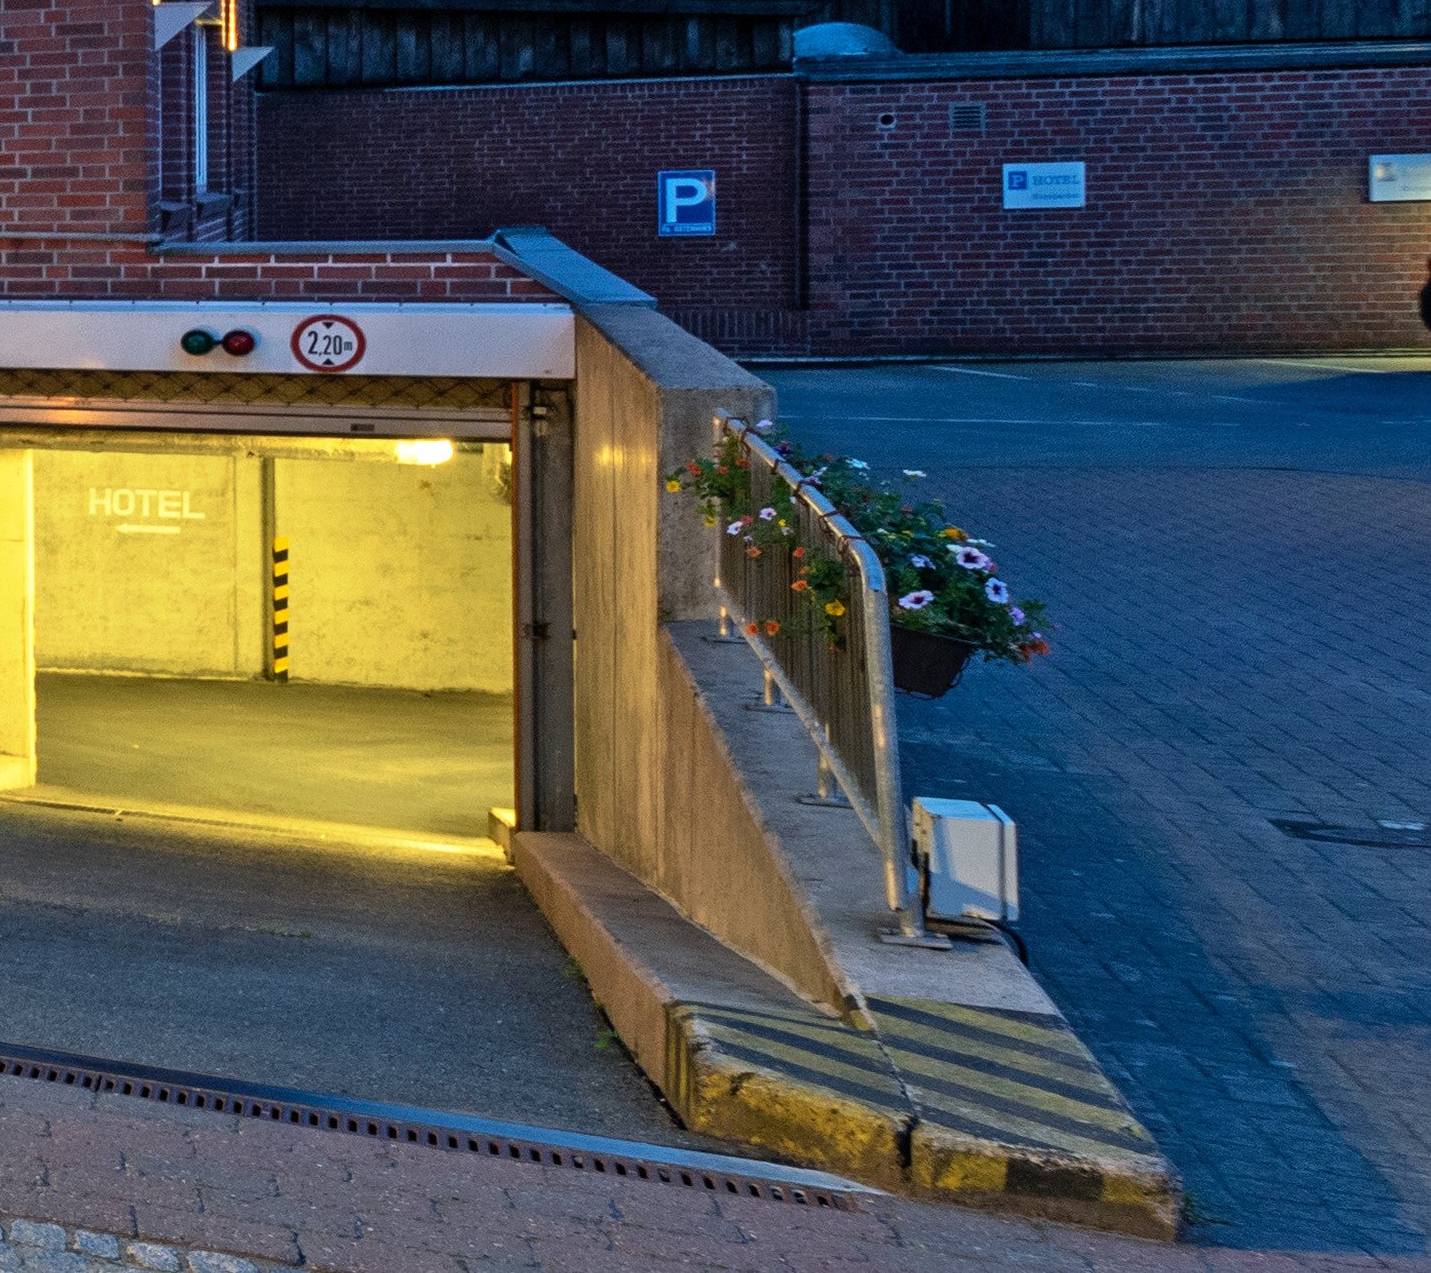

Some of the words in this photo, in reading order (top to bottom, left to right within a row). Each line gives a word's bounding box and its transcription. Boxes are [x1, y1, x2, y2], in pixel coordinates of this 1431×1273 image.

[1032, 175, 1081, 186] HOTEL
[666, 178, 707, 223] P
[89, 487, 206, 519] HOTEL
